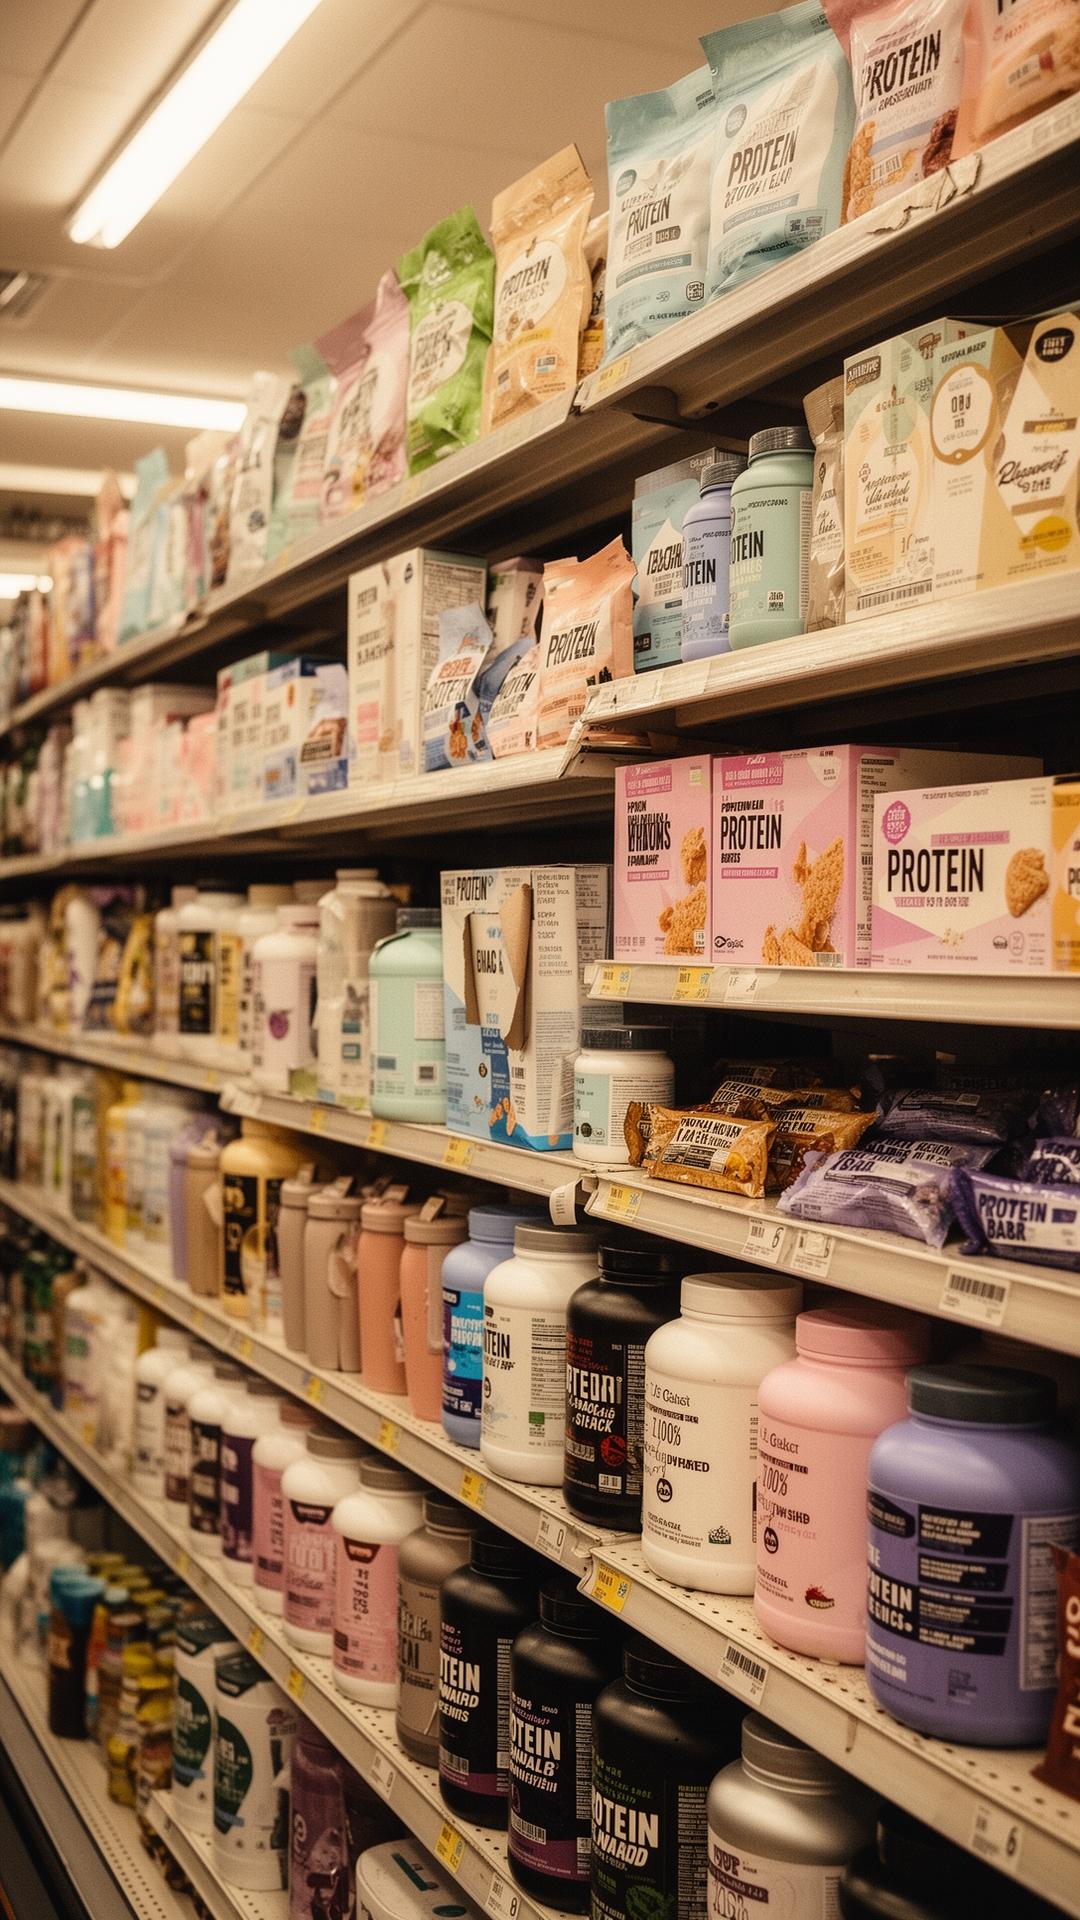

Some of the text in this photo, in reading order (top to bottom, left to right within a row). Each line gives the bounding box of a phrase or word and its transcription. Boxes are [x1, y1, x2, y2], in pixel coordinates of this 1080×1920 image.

[727, 125, 799, 187] PROTEIN
[546, 619, 600, 669] PROTEIN
[721, 814, 782, 850] PROTEIN
[887, 848, 984, 893] PROTEIN
[978, 1192, 1048, 1224] PROTEIN
